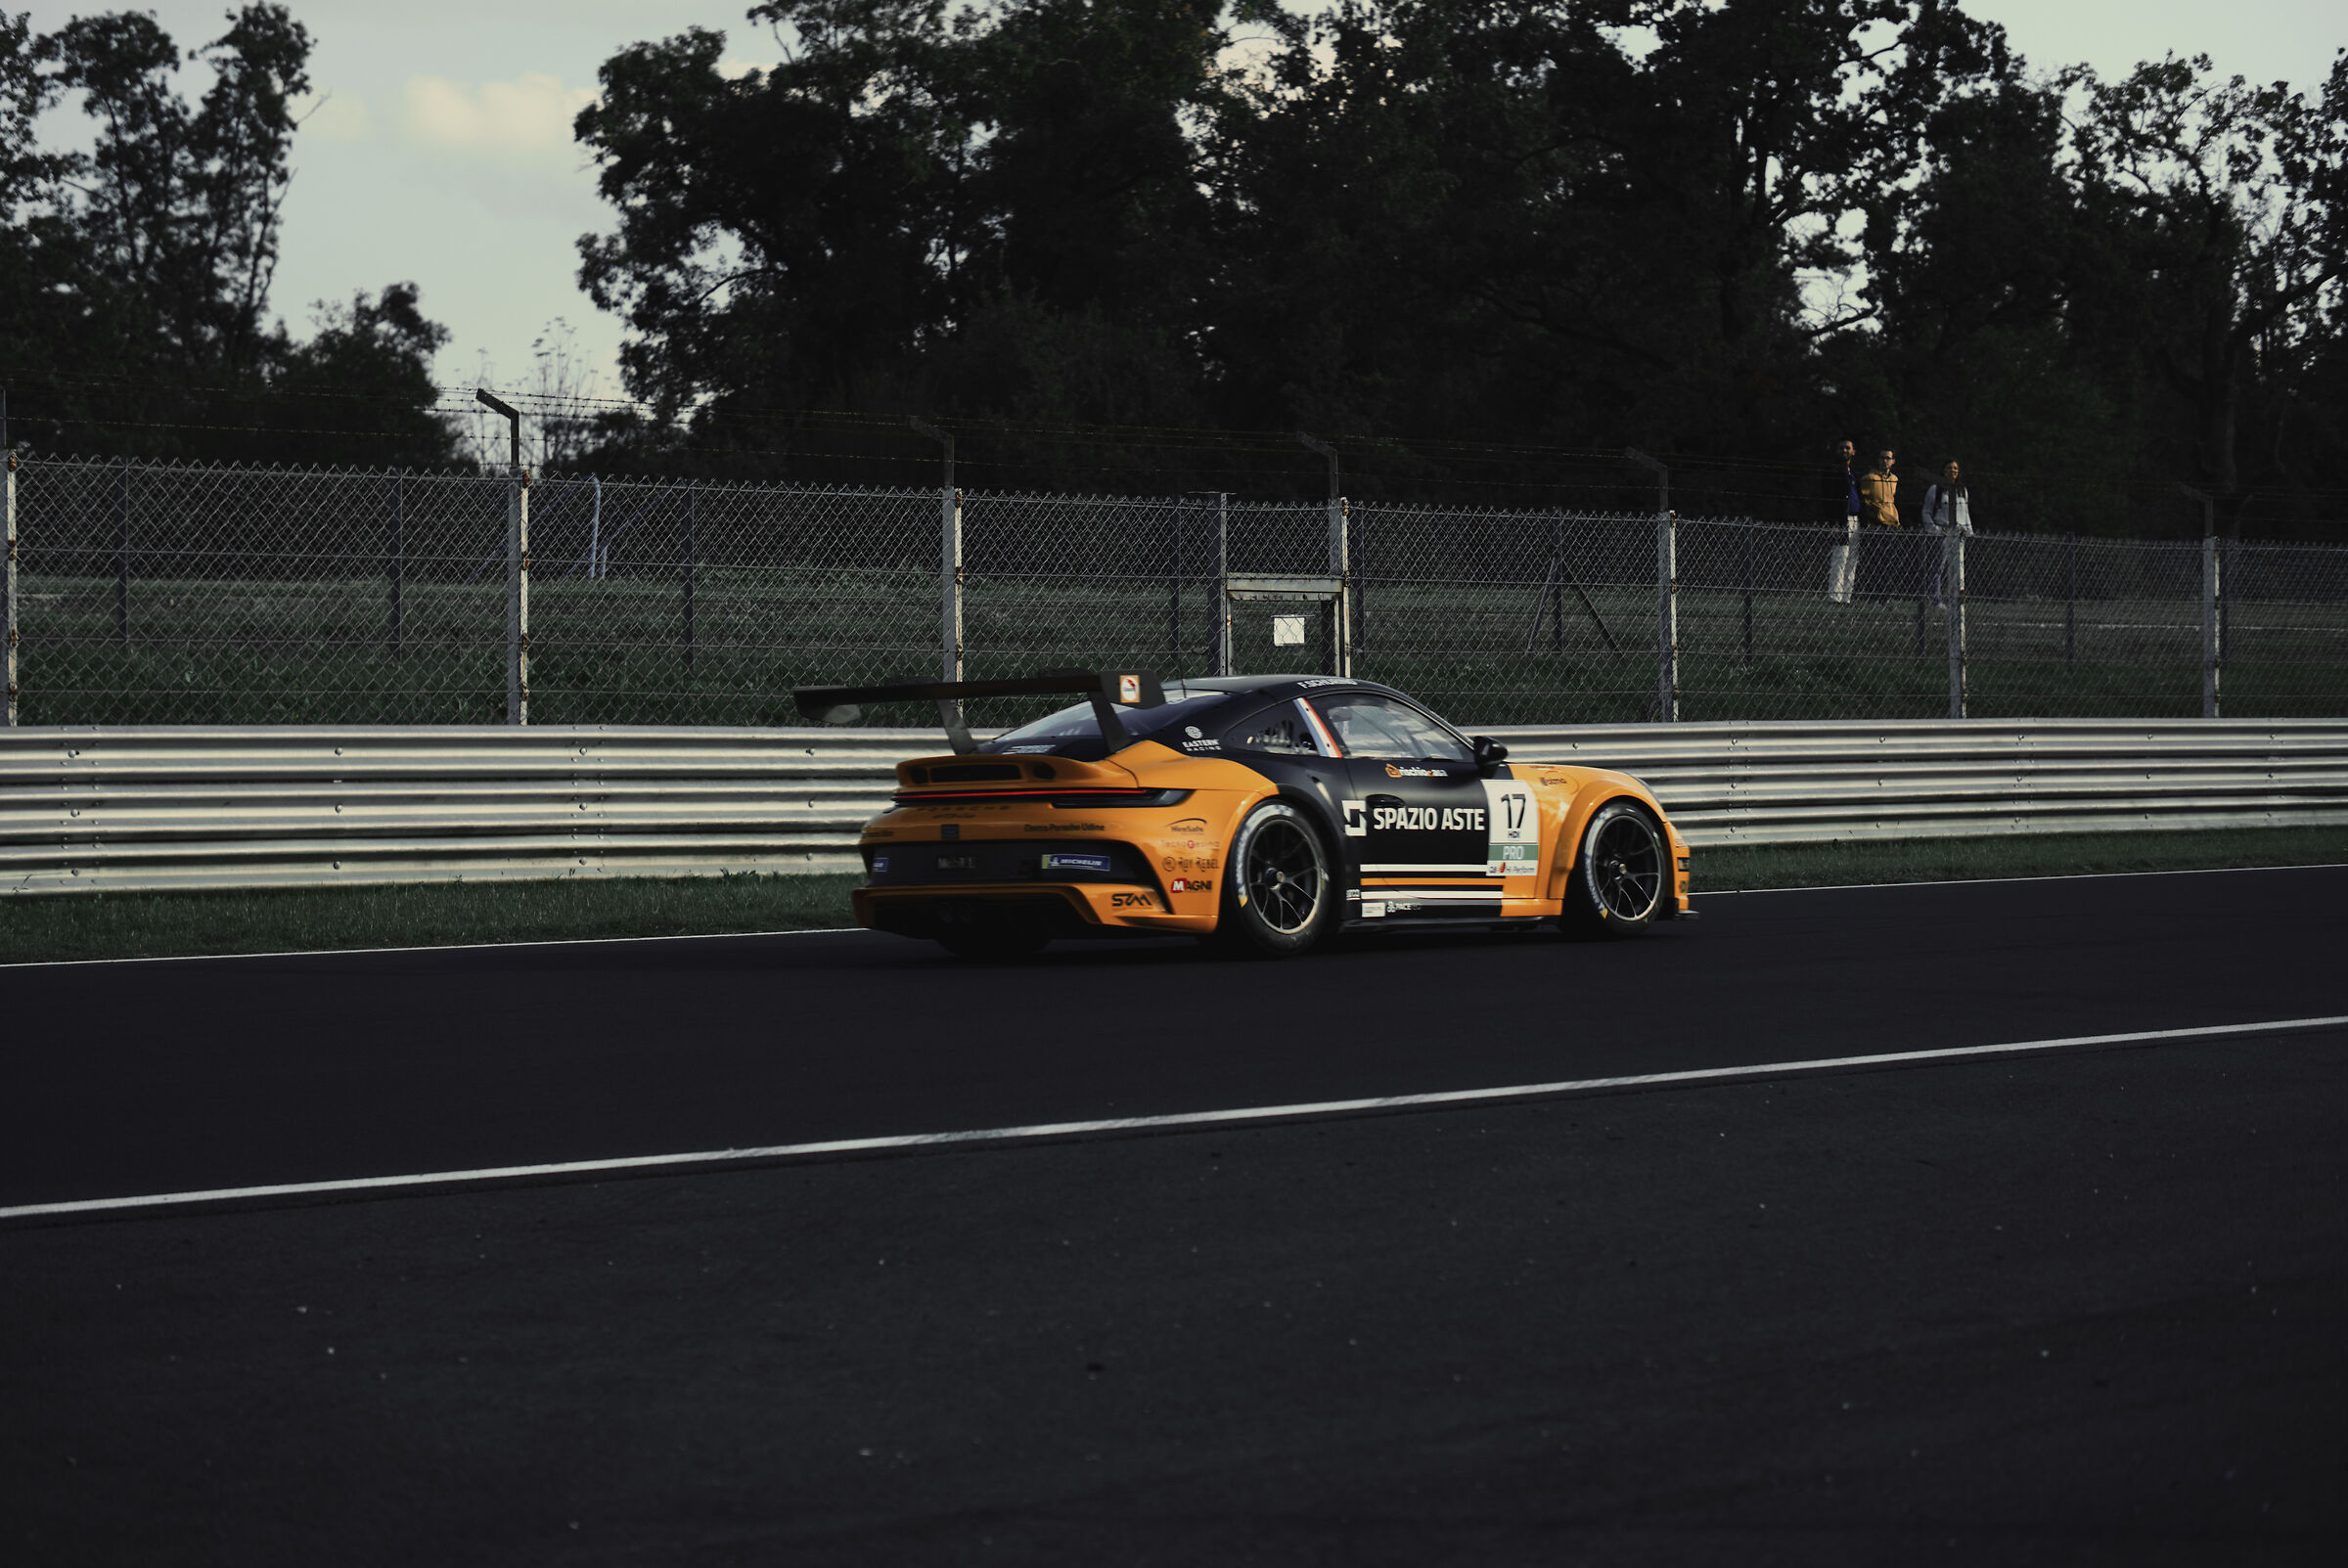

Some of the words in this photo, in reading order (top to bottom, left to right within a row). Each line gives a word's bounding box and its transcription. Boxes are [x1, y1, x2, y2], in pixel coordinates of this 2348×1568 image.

[1182, 739, 1220, 748] EASTERN
[1501, 794, 1526, 829] 17
[1373, 807, 1438, 830] SPAZIO
[1441, 807, 1486, 830] ASTE
[1049, 824, 1080, 832] Porsche
[1081, 822, 1105, 831] Udine
[1503, 845, 1525, 861] PRO
[1060, 857, 1103, 867] MICHELIN
[1172, 879, 1212, 891] MAGNI
